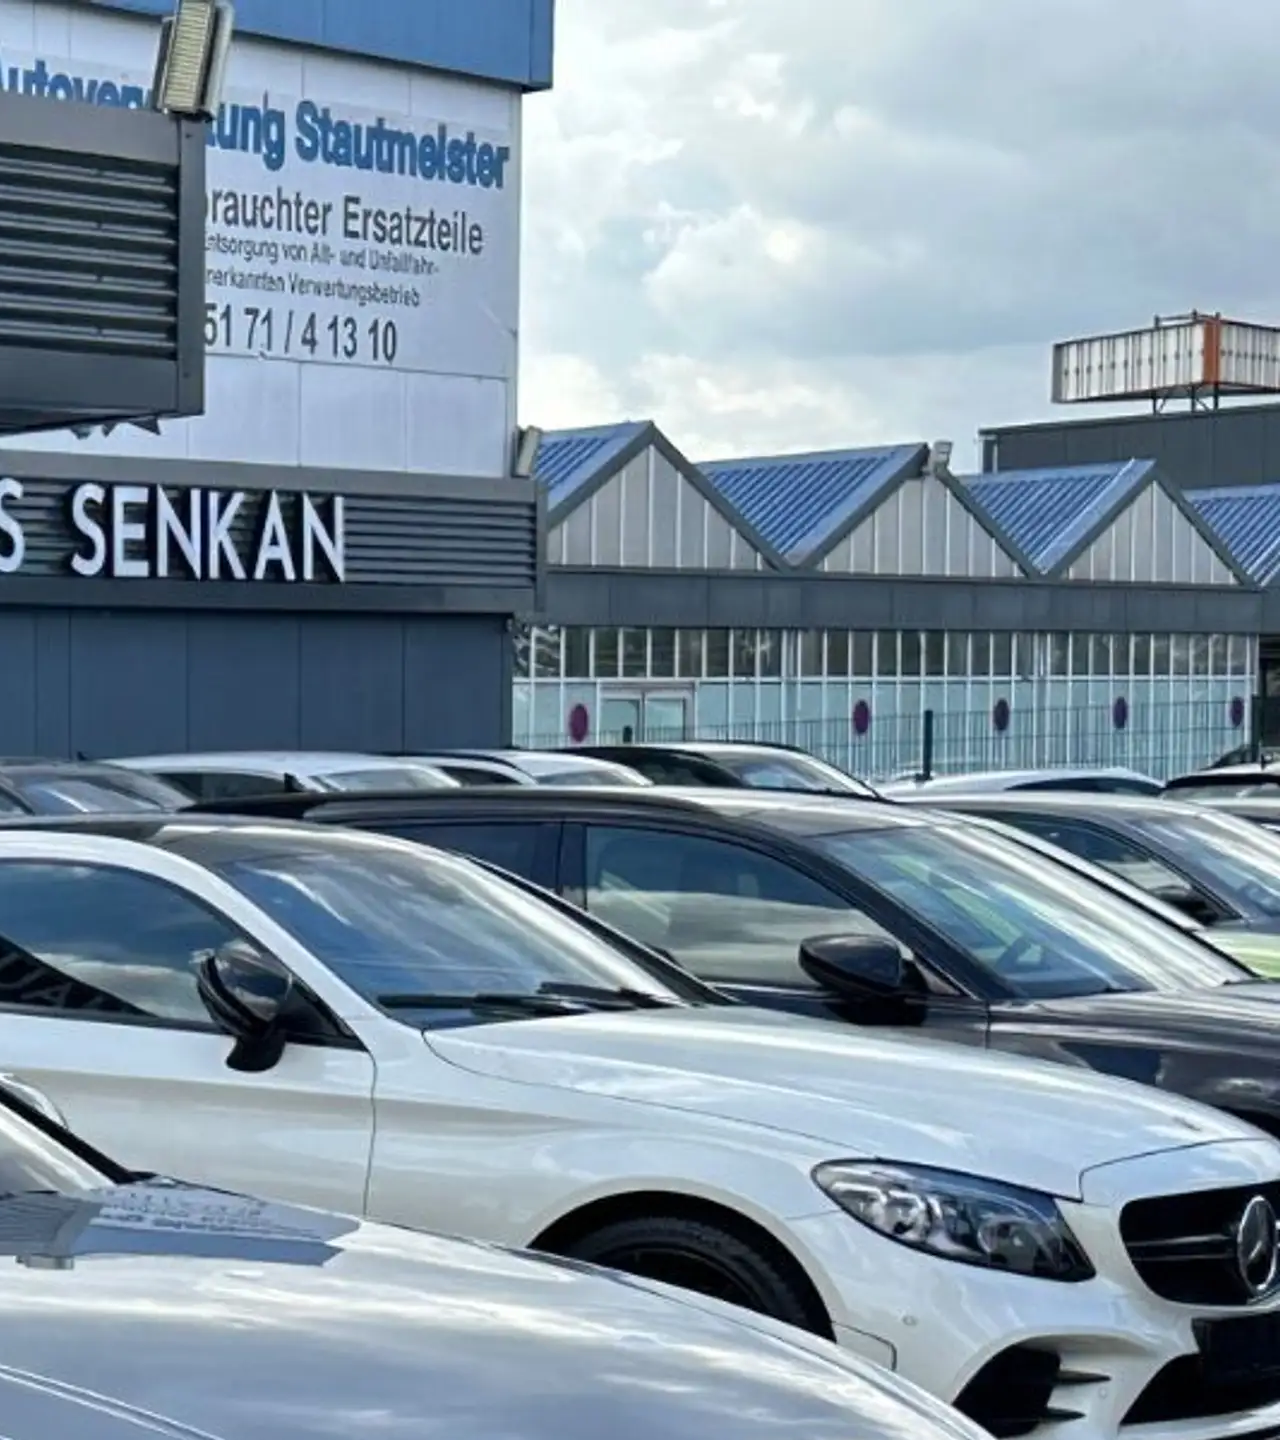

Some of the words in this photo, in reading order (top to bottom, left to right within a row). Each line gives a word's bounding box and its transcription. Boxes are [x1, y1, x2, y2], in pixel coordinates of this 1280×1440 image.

[295, 100, 509, 189] Stautmeister
[205, 186, 333, 236] rauchter
[343, 196, 483, 254] Ersatzteile
[281, 243, 307, 261] von
[340, 247, 366, 269] und
[205, 303, 232, 346] 51
[244, 307, 272, 351] 71
[284, 310, 294, 353] /
[301, 311, 318, 355] 4
[328, 315, 357, 359] 13
[368, 318, 397, 362] 10
[70, 482, 345, 582] SENKAN
